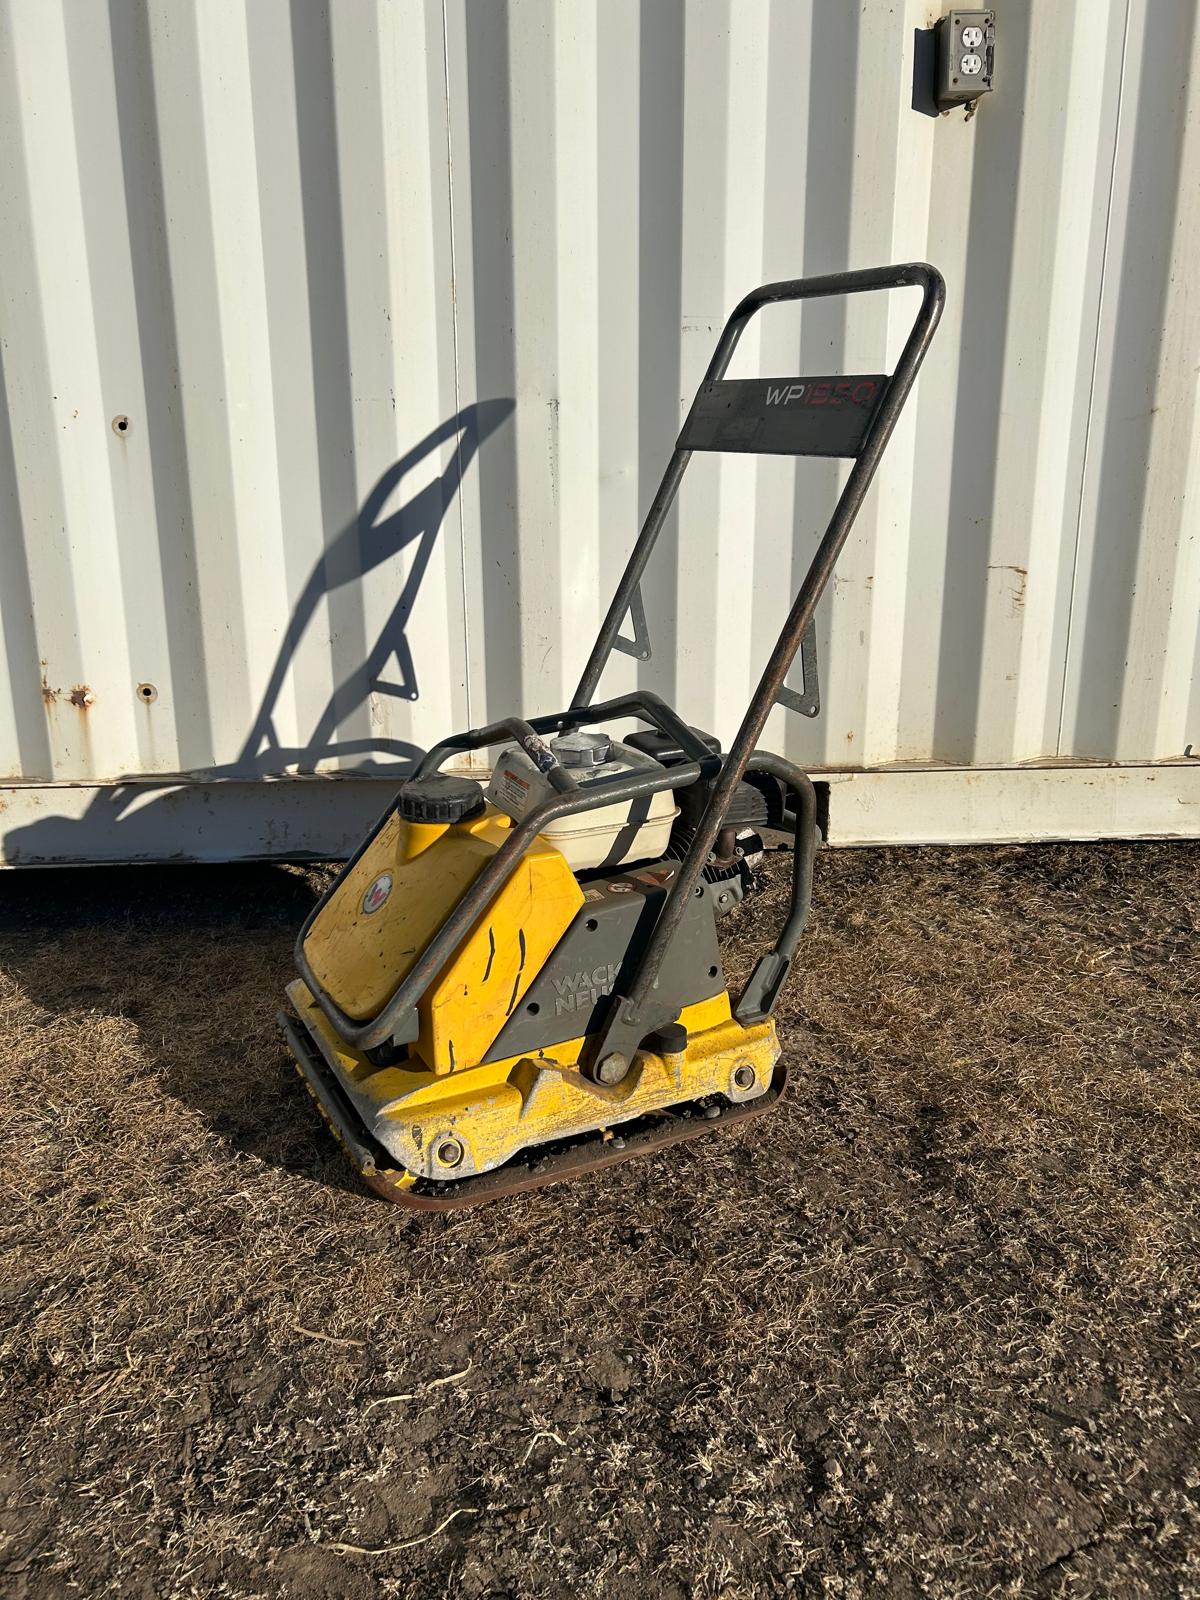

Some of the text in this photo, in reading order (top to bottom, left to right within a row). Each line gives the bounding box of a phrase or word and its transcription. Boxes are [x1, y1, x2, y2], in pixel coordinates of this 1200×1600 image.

[765, 381, 877, 406] WP1550
[551, 960, 623, 995] WACK
[554, 982, 616, 1017] NEU
